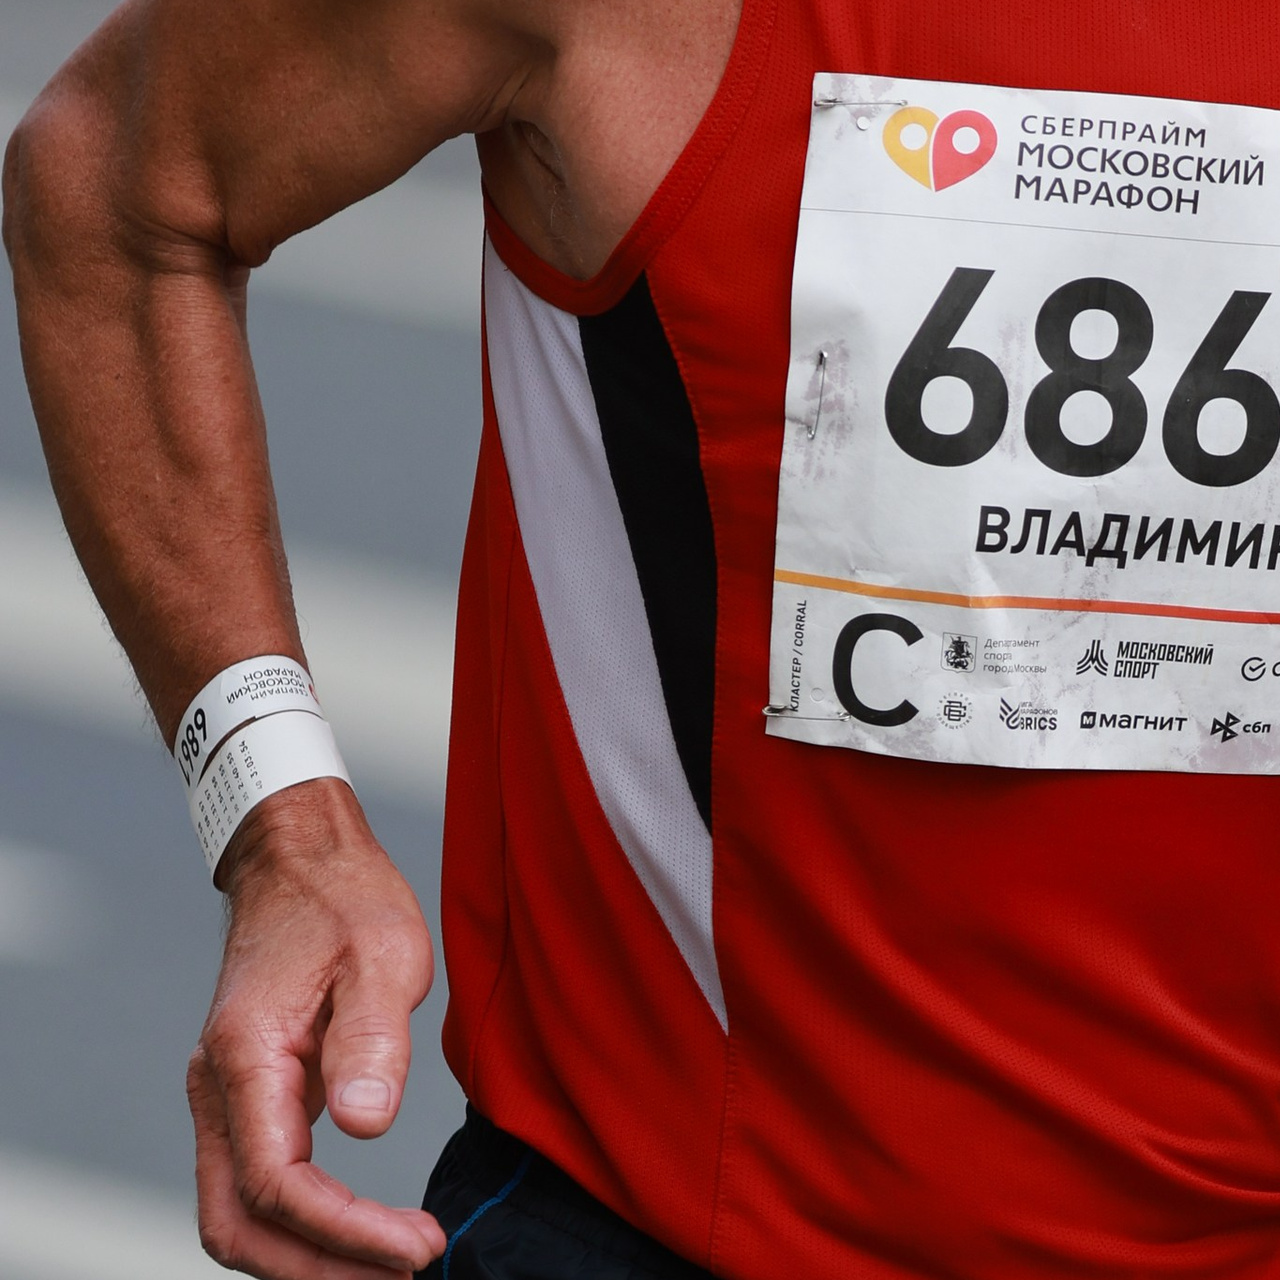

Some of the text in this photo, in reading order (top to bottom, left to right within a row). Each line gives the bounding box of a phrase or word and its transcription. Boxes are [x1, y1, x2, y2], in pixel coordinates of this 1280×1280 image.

[1021, 115, 1207, 148] СБЕРПРАЙМ
[1017, 142, 1265, 186] МОСКОВСКИЙ
[1014, 174, 1200, 215] МАРАФОН
[794, 600, 807, 647] CORRAL
[1114, 660, 1159, 679] СПОРТ
[1117, 641, 1214, 665] МОСКОВСКИЙ
[226, 677, 306, 704] МОСКОВСКИЙ
[790, 657, 801, 712] КЛАСТЕР
[1099, 713, 1188, 731] магнит
[1243, 722, 1271, 733] сбп
[178, 708, 207, 787] 6861
